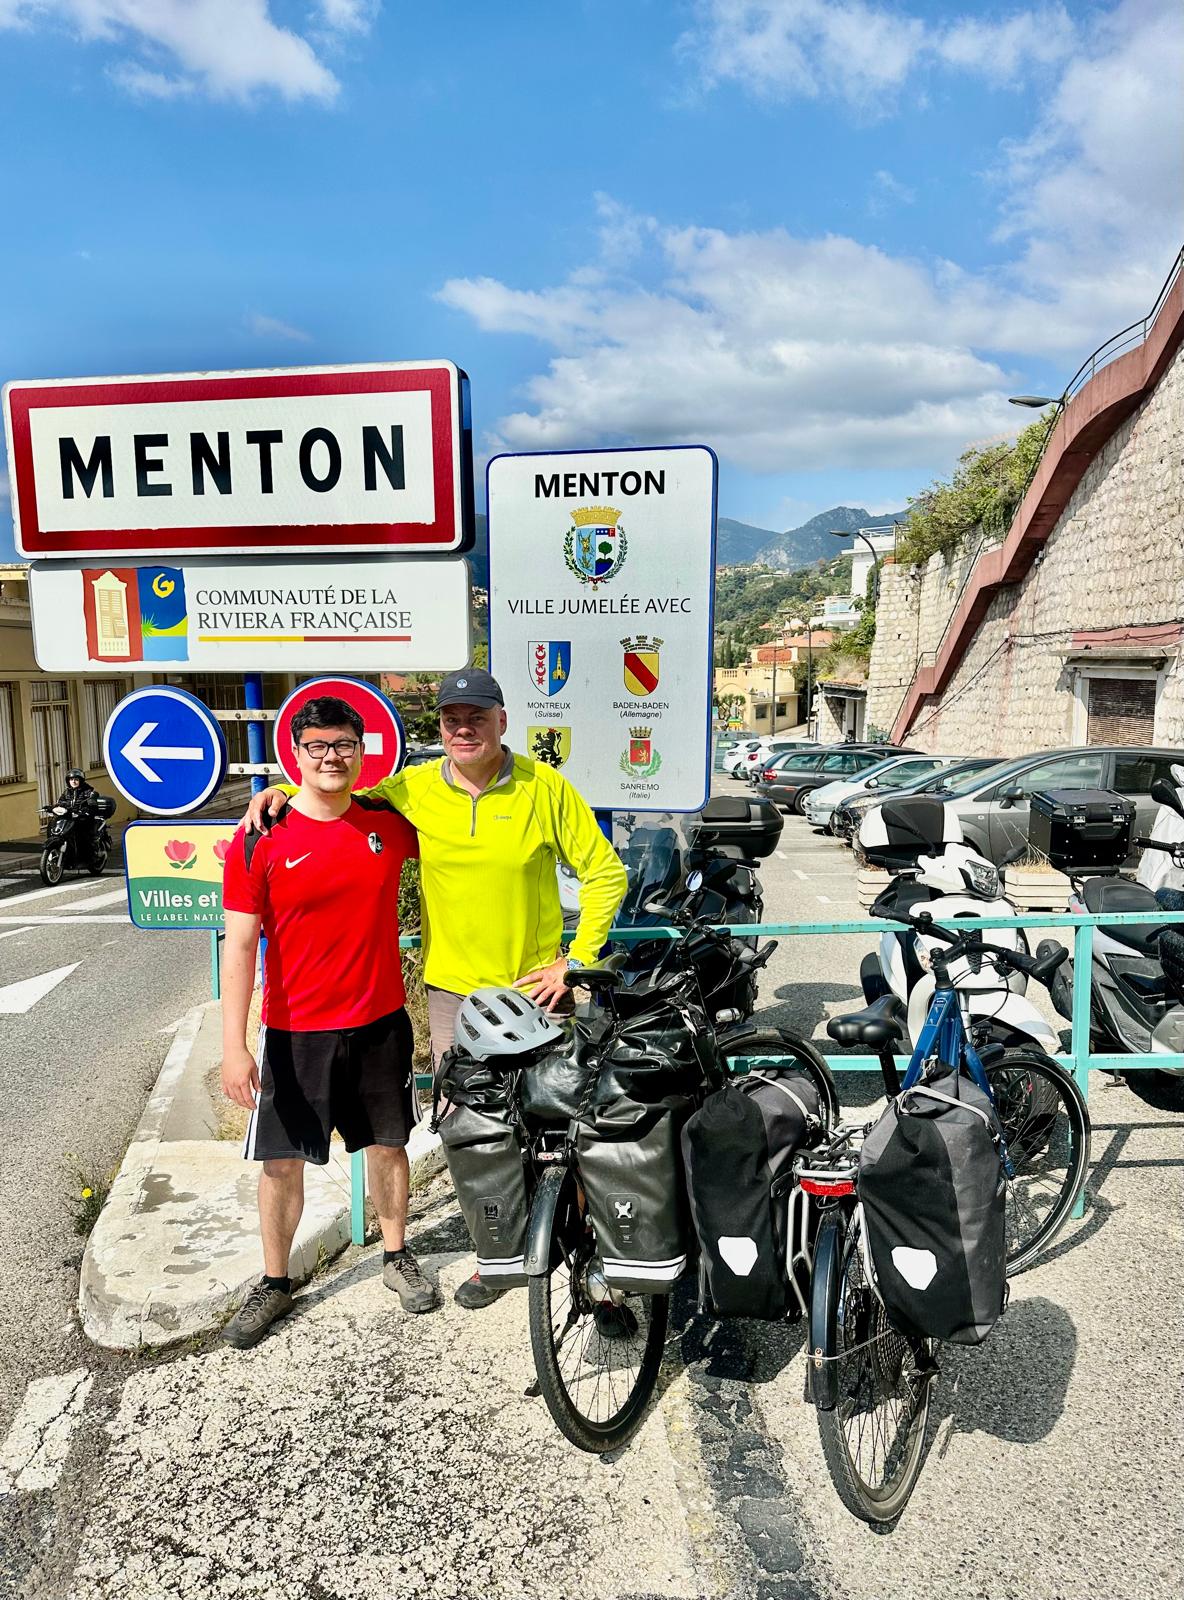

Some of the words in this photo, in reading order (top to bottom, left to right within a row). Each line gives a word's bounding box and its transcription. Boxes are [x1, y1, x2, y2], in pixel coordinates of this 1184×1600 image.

[58, 424, 406, 499] MENTON
[535, 470, 665, 498] MENTON
[196, 585, 336, 605] COMMUNAUTÉ
[341, 589, 367, 605] DE
[371, 588, 398, 605] LA
[508, 599, 555, 614] VILLE
[558, 593, 640, 615] JUMELÉE
[644, 597, 692, 613] AVEC
[197, 612, 285, 629] RIVIERA
[290, 611, 413, 633] FRANÇAISE
[534, 711, 563, 719] (Suisse)
[619, 711, 662, 719] (Allemagne)
[620, 782, 660, 791] SANREMO
[629, 792, 651, 800] (Italie)
[138, 889, 193, 908] Villes
[198, 891, 219, 908] et
[140, 913, 152, 921] LE
[157, 913, 189, 921] LABEL
